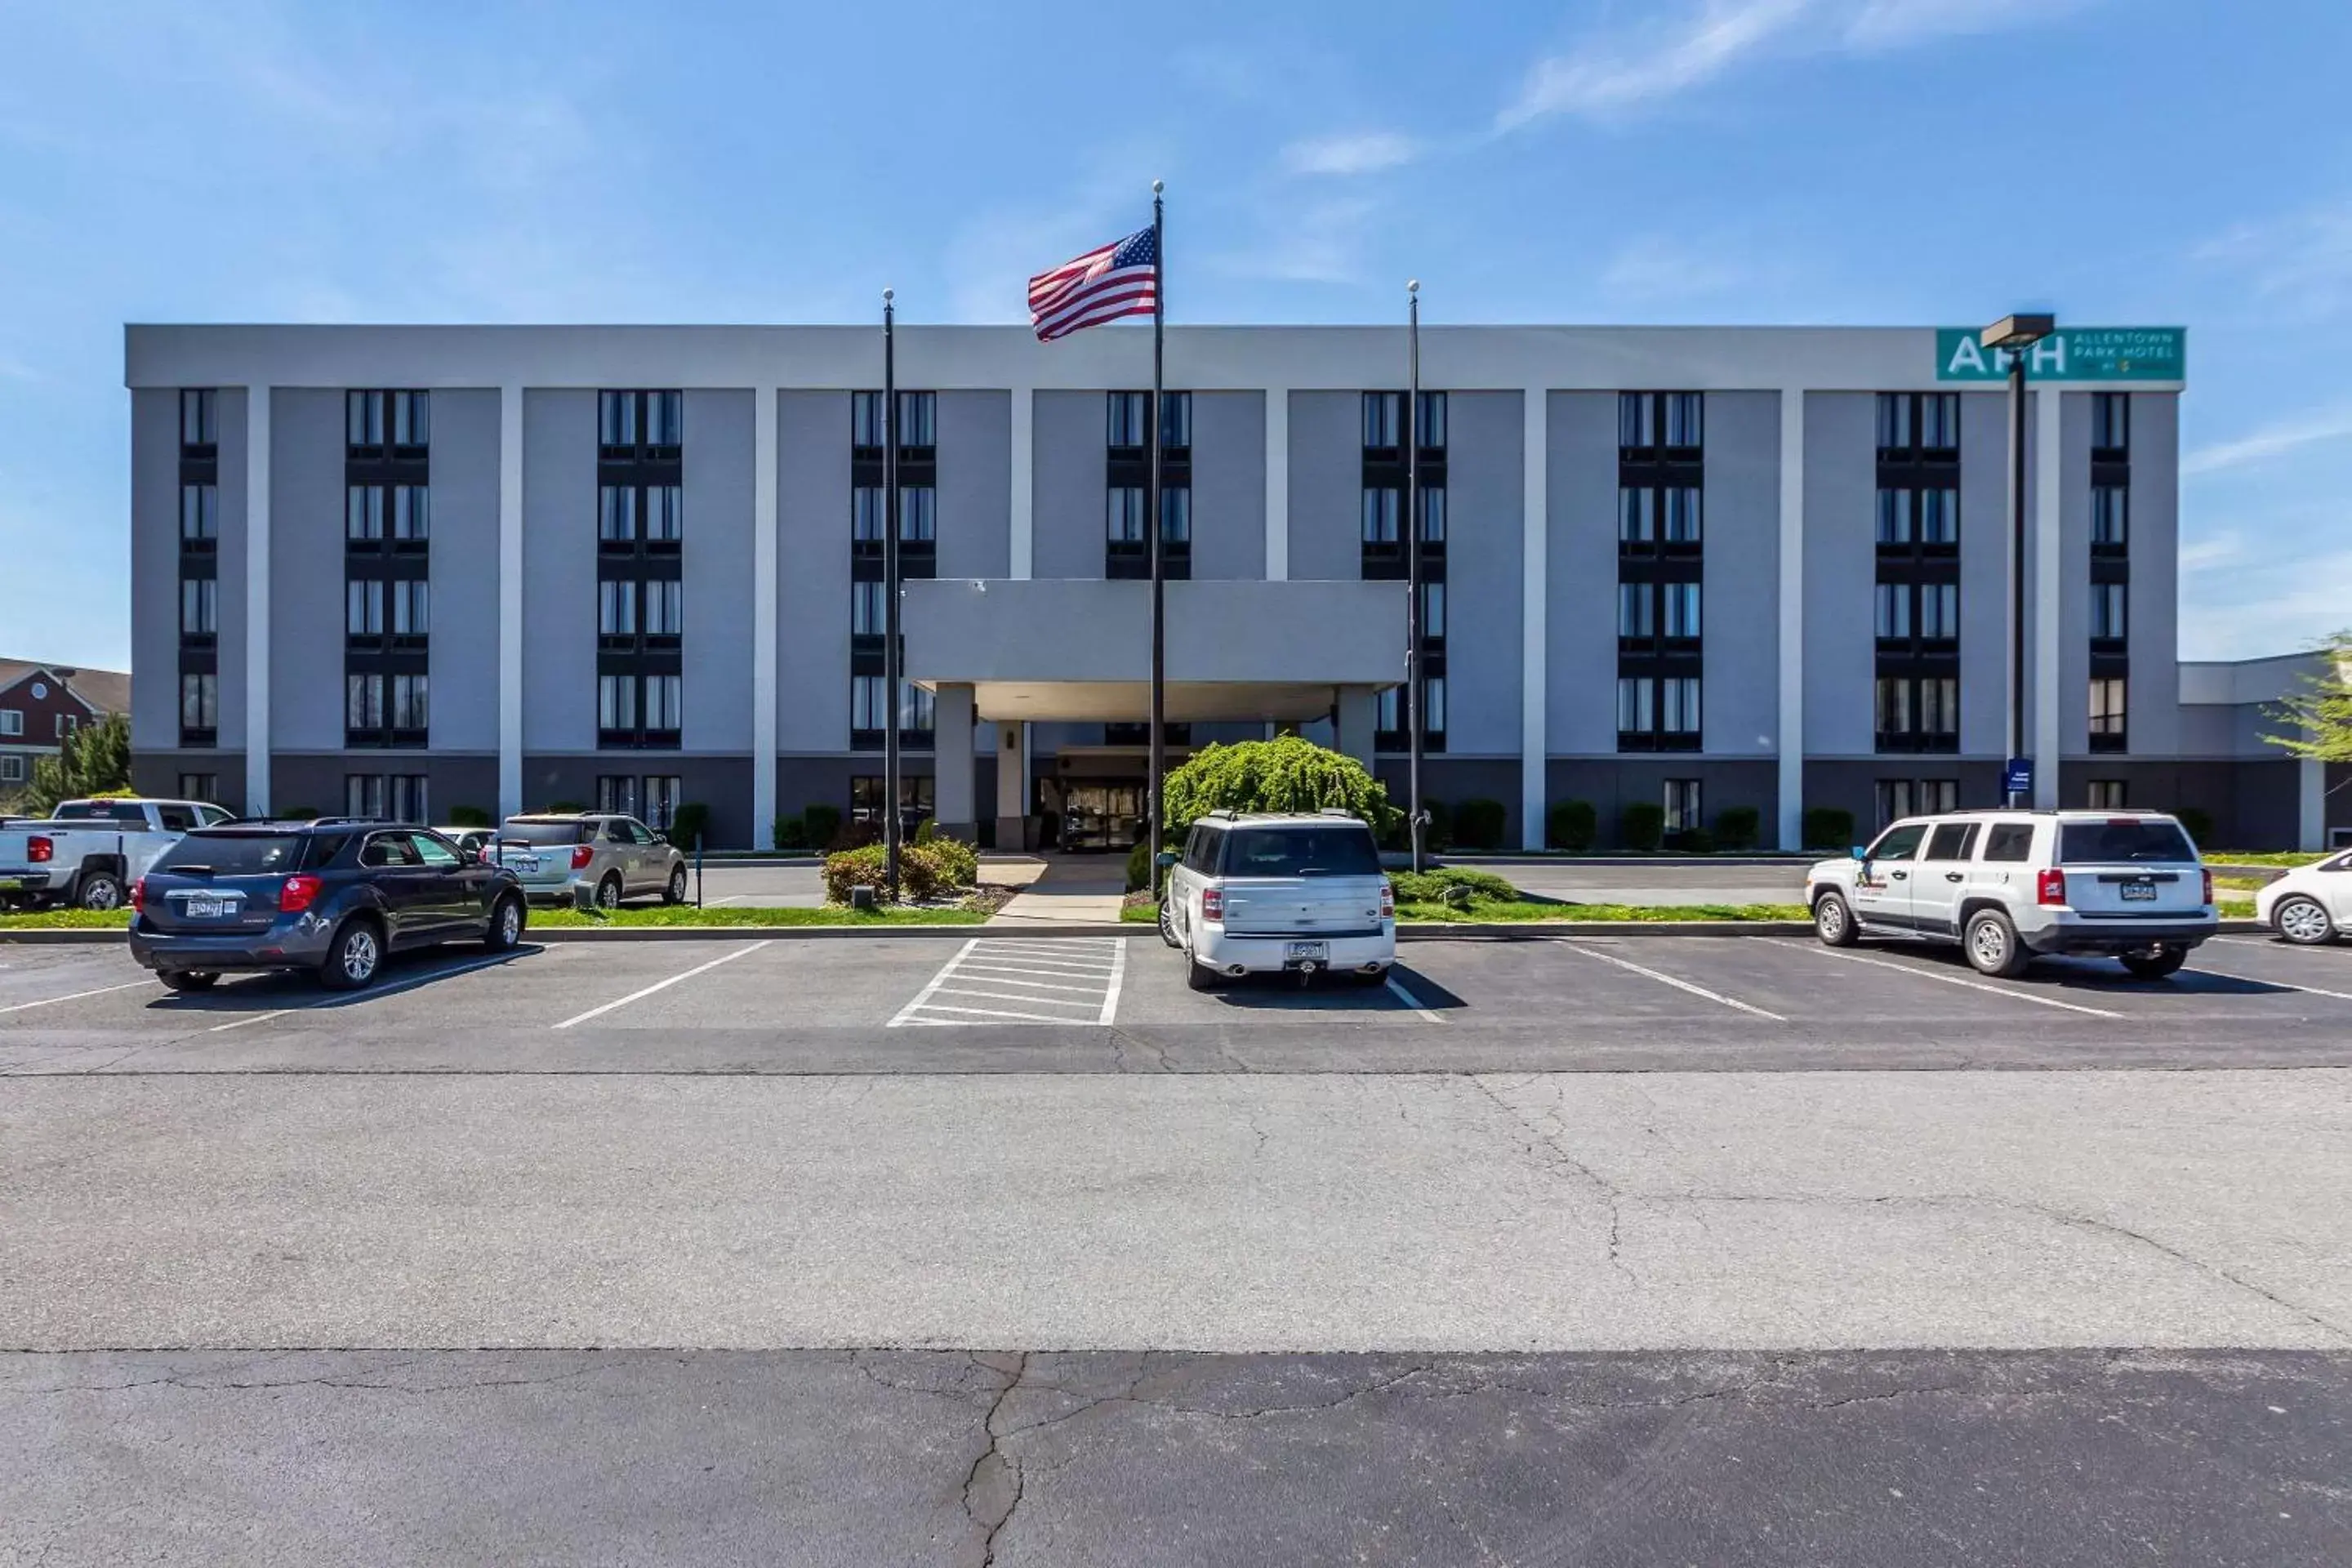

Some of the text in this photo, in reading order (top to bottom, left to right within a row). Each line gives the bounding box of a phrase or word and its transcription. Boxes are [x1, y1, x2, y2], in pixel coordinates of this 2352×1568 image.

[2074, 332, 2173, 344] ALLENTOWN
[2074, 346, 2173, 358] PARK HOTEL
